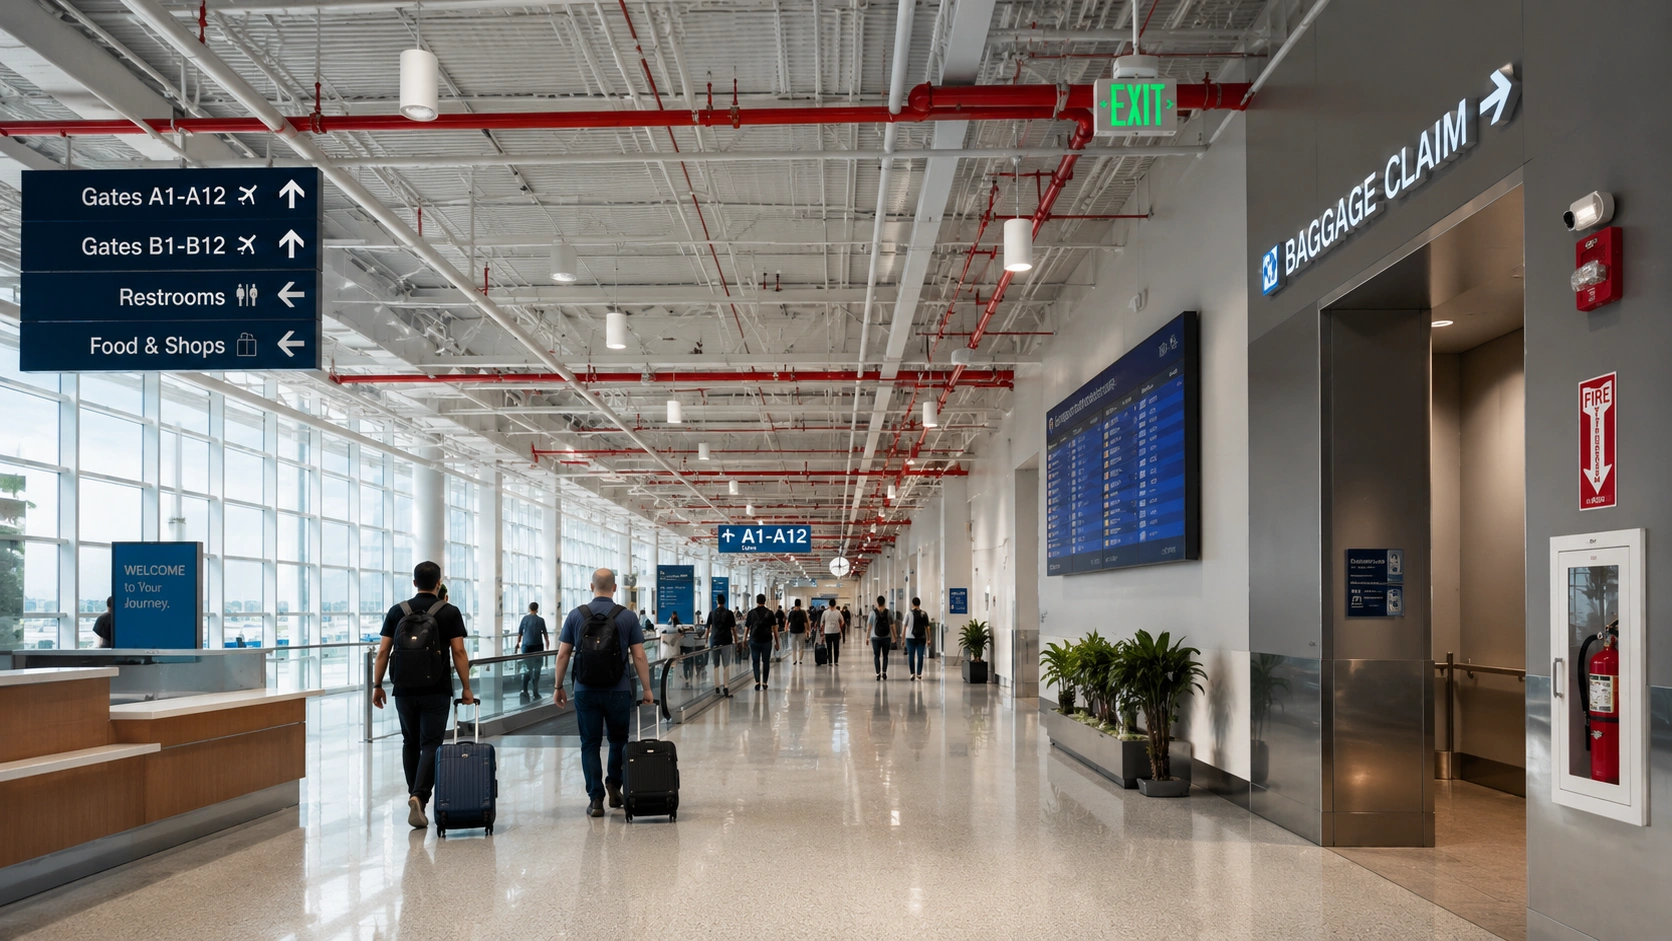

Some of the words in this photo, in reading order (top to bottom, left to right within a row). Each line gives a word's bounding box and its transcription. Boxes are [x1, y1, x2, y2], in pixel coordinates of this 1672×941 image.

[1110, 83, 1165, 127] EXIT
[81, 187, 143, 206] Gates
[148, 186, 226, 206] A1-A12
[1285, 171, 1377, 277] BAGGAGE
[1384, 97, 1467, 200] CLAIM
[81, 236, 143, 256] Gates
[149, 236, 226, 255] B1-B12
[119, 288, 226, 306] Restrooms
[90, 336, 138, 355] Food
[144, 337, 159, 355] &
[165, 337, 226, 358] Shops
[1584, 386, 1610, 408] FIRE
[741, 528, 807, 544] A1-A12
[124, 565, 185, 576] WELCOME
[124, 583, 136, 592] to
[138, 581, 162, 593] Your
[124, 597, 170, 612] Journey.
